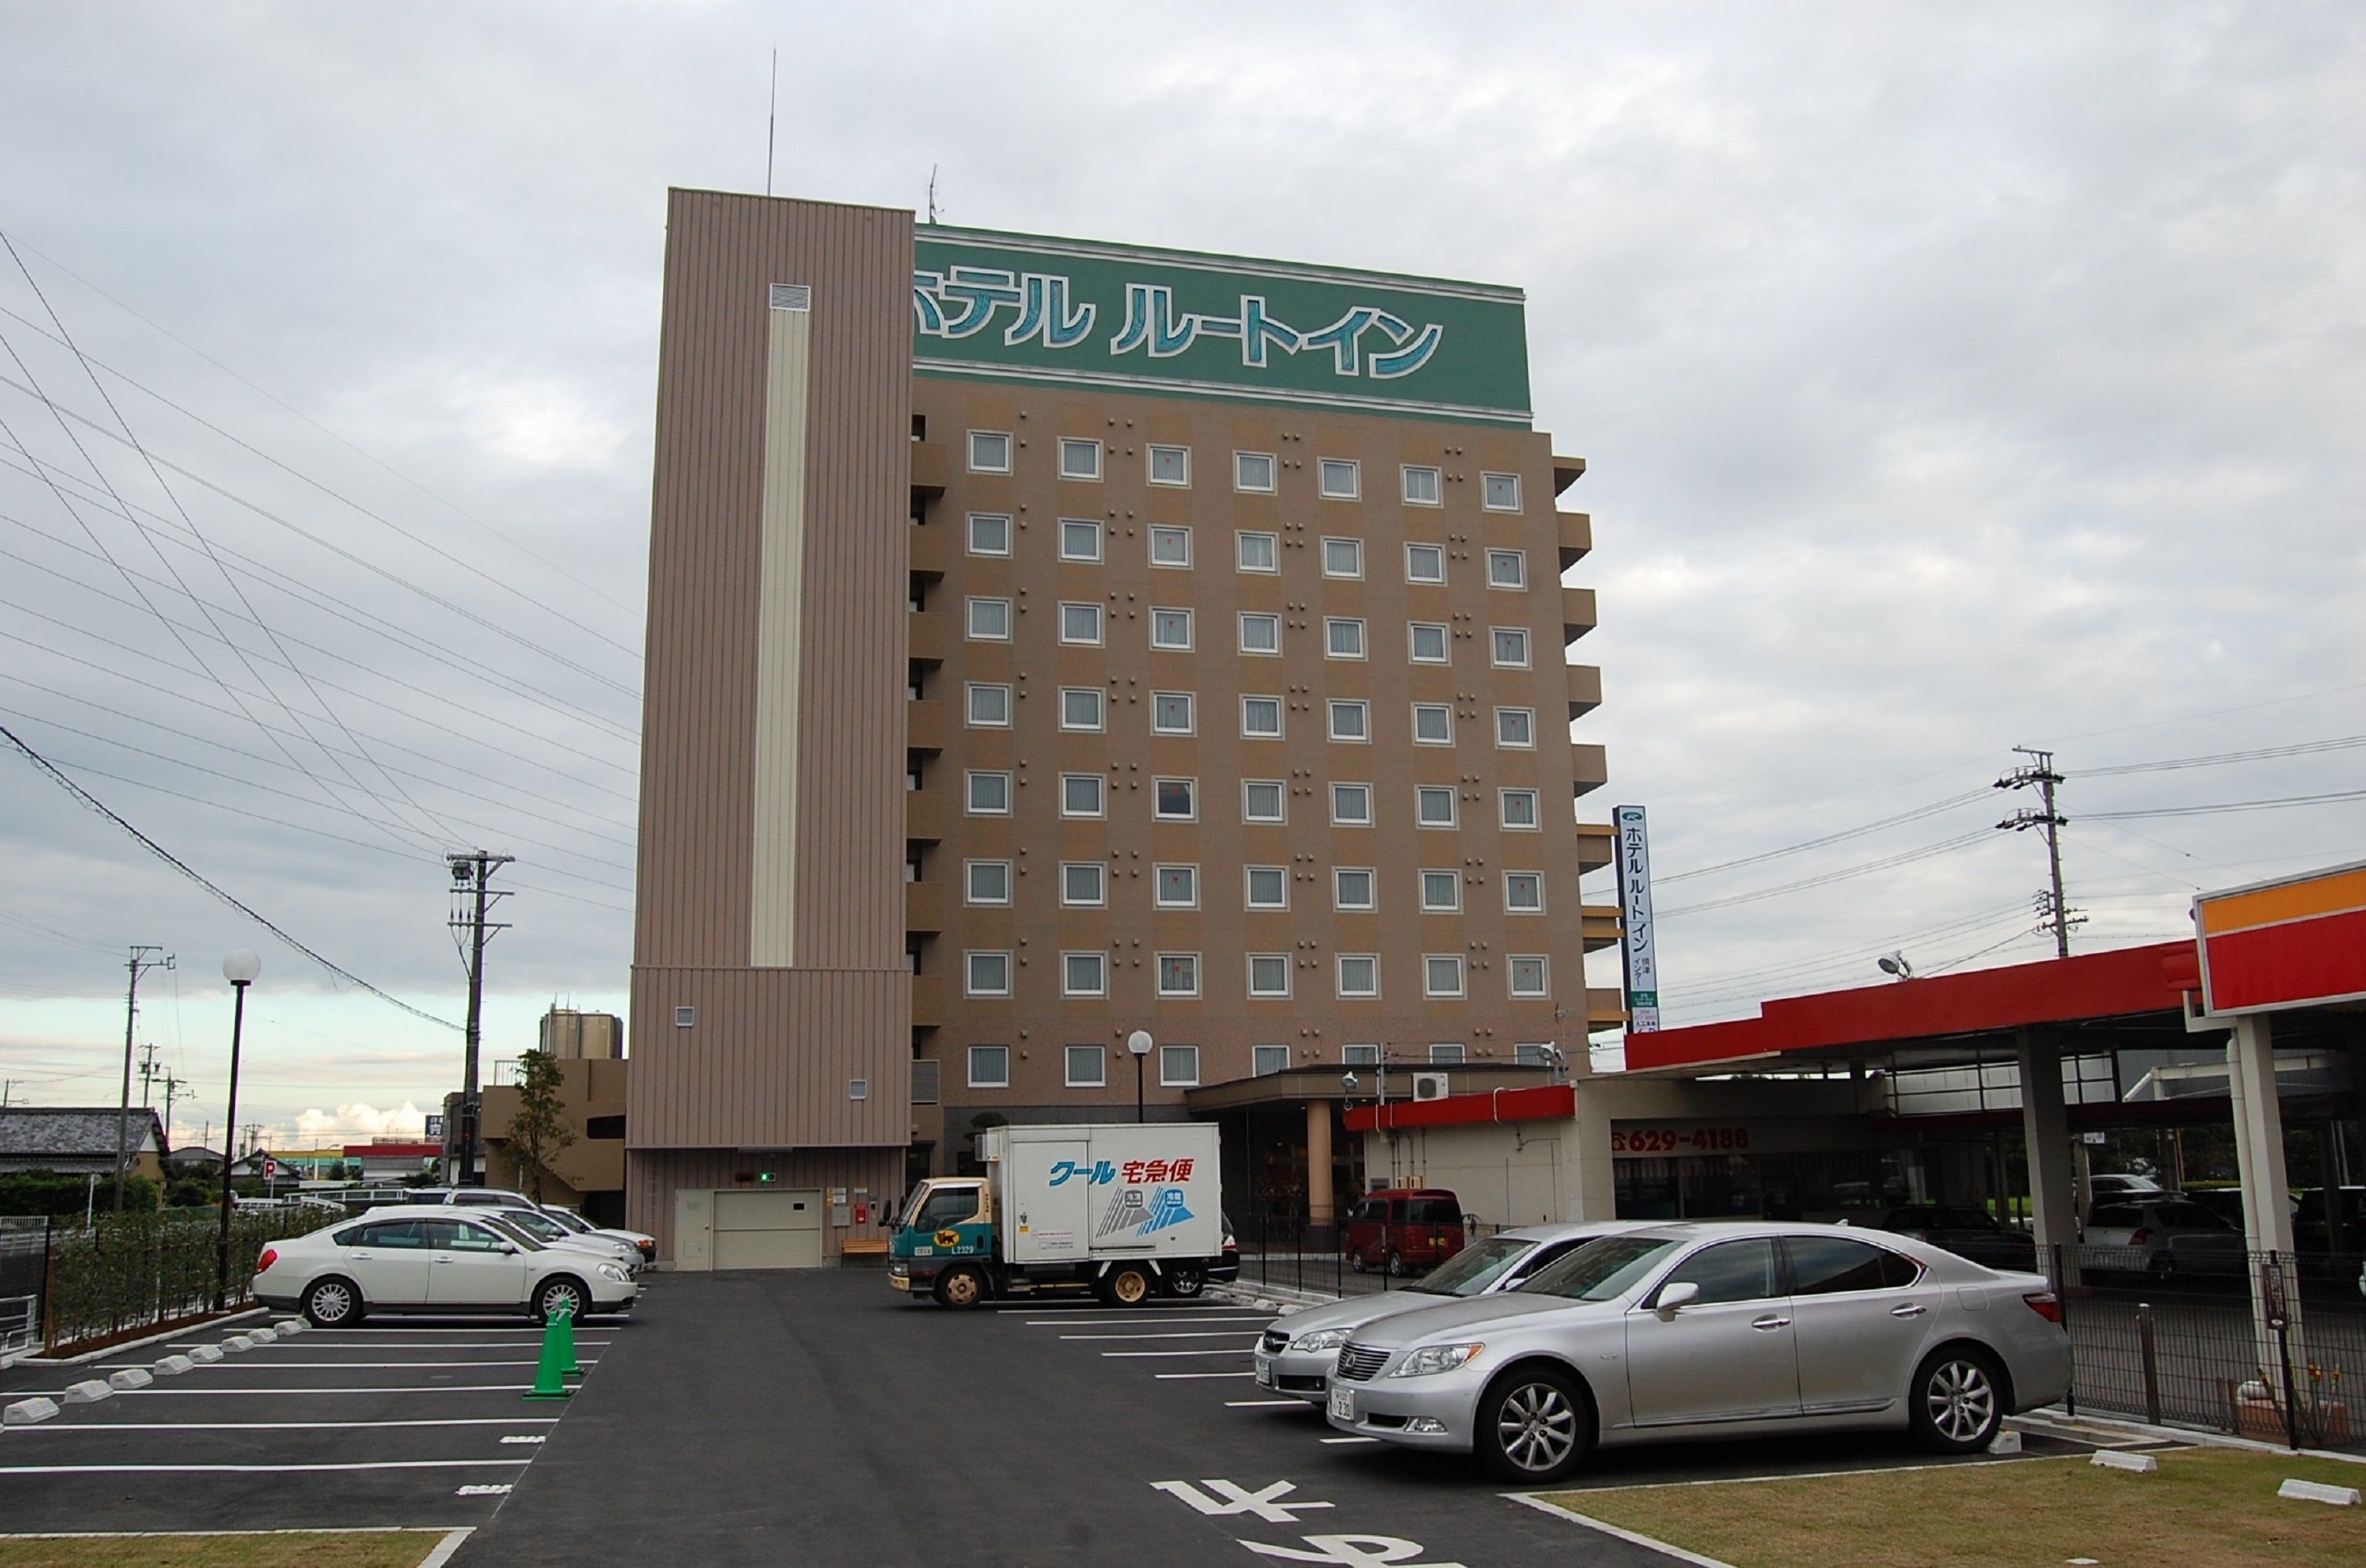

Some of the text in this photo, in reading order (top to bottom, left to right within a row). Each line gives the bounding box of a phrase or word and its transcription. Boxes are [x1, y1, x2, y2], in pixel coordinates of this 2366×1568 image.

[1111, 283, 1443, 379] ルートイン
[1626, 827, 1648, 952] ホテル ルートイン
[1629, 1128, 1749, 1152] 629-4188
[266, 1162, 275, 1177] P
[1048, 1158, 1195, 1186] クール 宅急便
